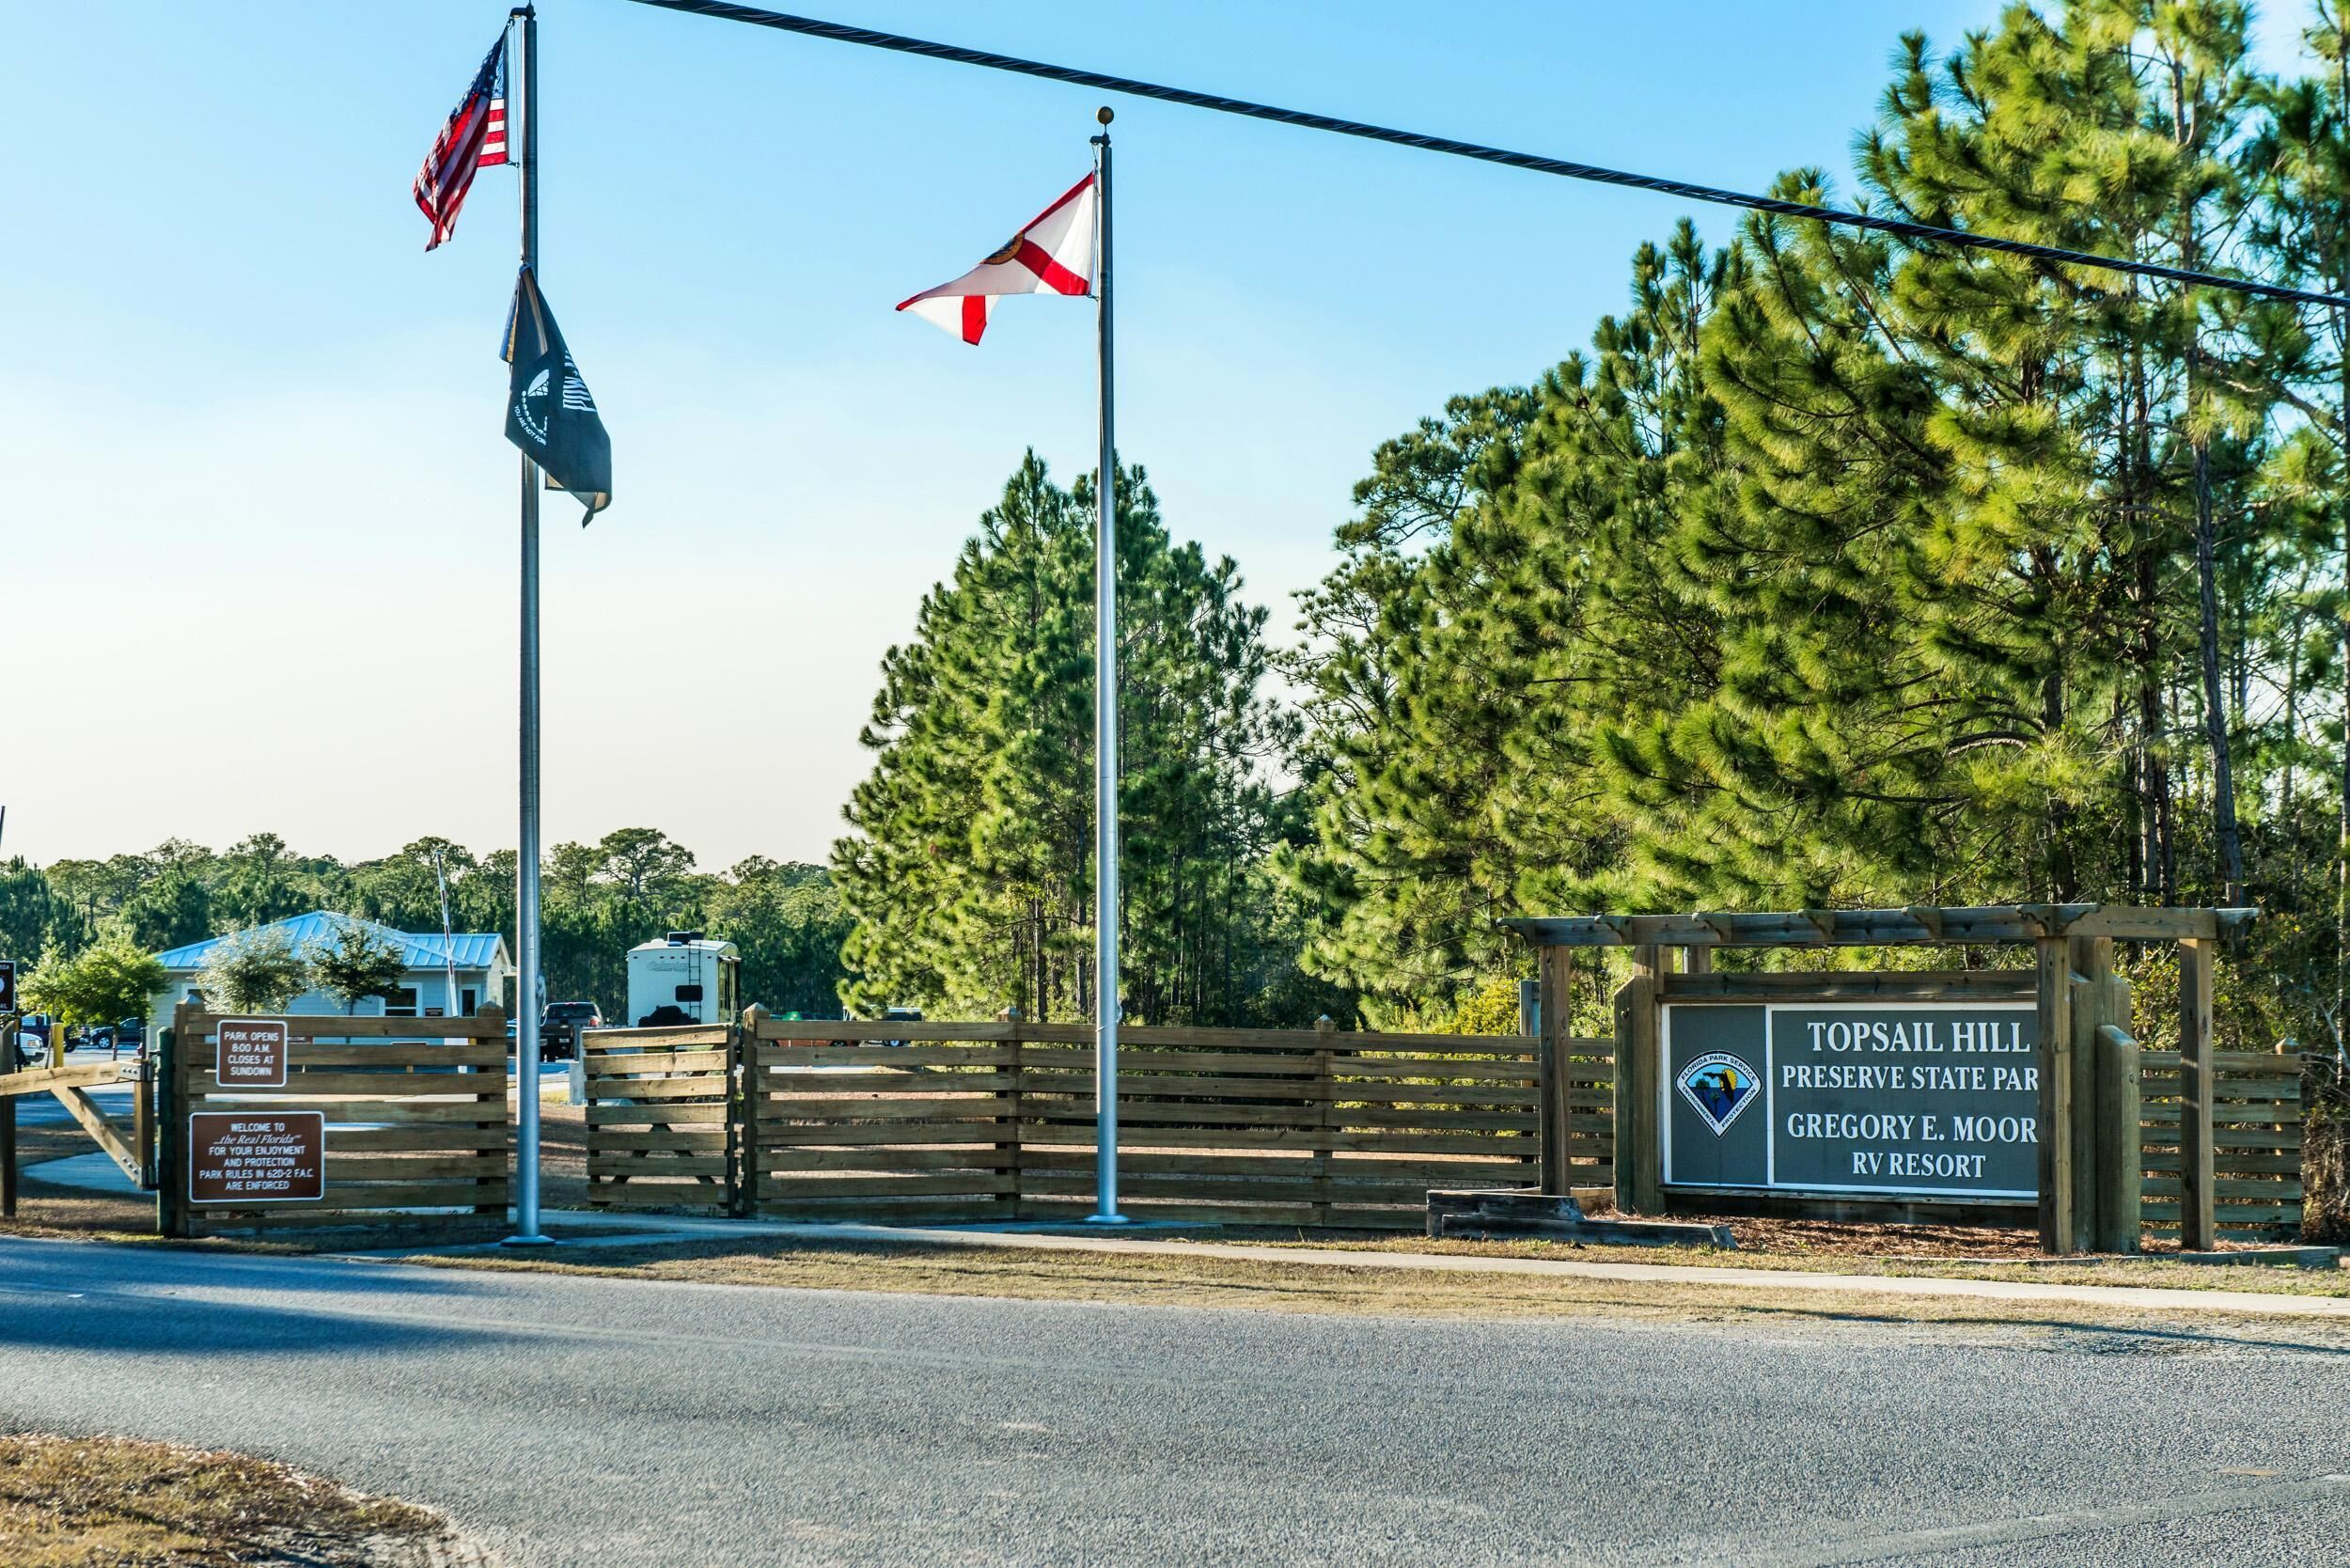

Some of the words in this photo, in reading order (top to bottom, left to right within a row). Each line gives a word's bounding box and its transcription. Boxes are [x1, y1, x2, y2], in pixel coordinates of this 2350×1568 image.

[518, 417, 527, 428] ARE
[525, 426, 536, 436] NOT
[224, 1031, 247, 1041] PARK
[250, 1032, 279, 1042] OPENS
[1807, 1022, 1944, 1052] TOPSAIL
[1951, 1022, 2030, 1053] HILL
[231, 1043, 252, 1053] 8:00
[227, 1055, 260, 1064] CLOSES
[263, 1055, 274, 1064] AT
[230, 1066, 273, 1076] SUNDOWN
[1681, 1058, 1708, 1080] FLORIDA
[1730, 1058, 1757, 1082] SERVICE
[1782, 1065, 1905, 1090] PRESERVE
[1911, 1066, 1987, 1090] STATE
[1682, 1086, 1716, 1128] ENVIRONMENTAL
[1721, 1089, 1756, 1128] PROTECTION
[230, 1122, 272, 1132] WELCOME
[274, 1122, 286, 1132] TO
[1787, 1113, 1916, 1140] GREGORY
[1921, 1115, 1945, 1141] E.
[237, 1135, 261, 1144] Real
[209, 1147, 227, 1155] FOR
[229, 1146, 253, 1155] YOUR
[255, 1146, 306, 1154] ENJOYMENT
[224, 1158, 243, 1167] AND
[244, 1157, 295, 1167] PROTECTION
[1853, 1152, 1884, 1175] RV
[1888, 1152, 1986, 1178] RESORT
[199, 1170, 223, 1179] PARK
[225, 1169, 254, 1179] RULES
[256, 1169, 265, 1178] IN
[267, 1168, 293, 1178] 62D-2
[226, 1181, 243, 1190] ARE
[245, 1180, 290, 1190] ENFORCED
